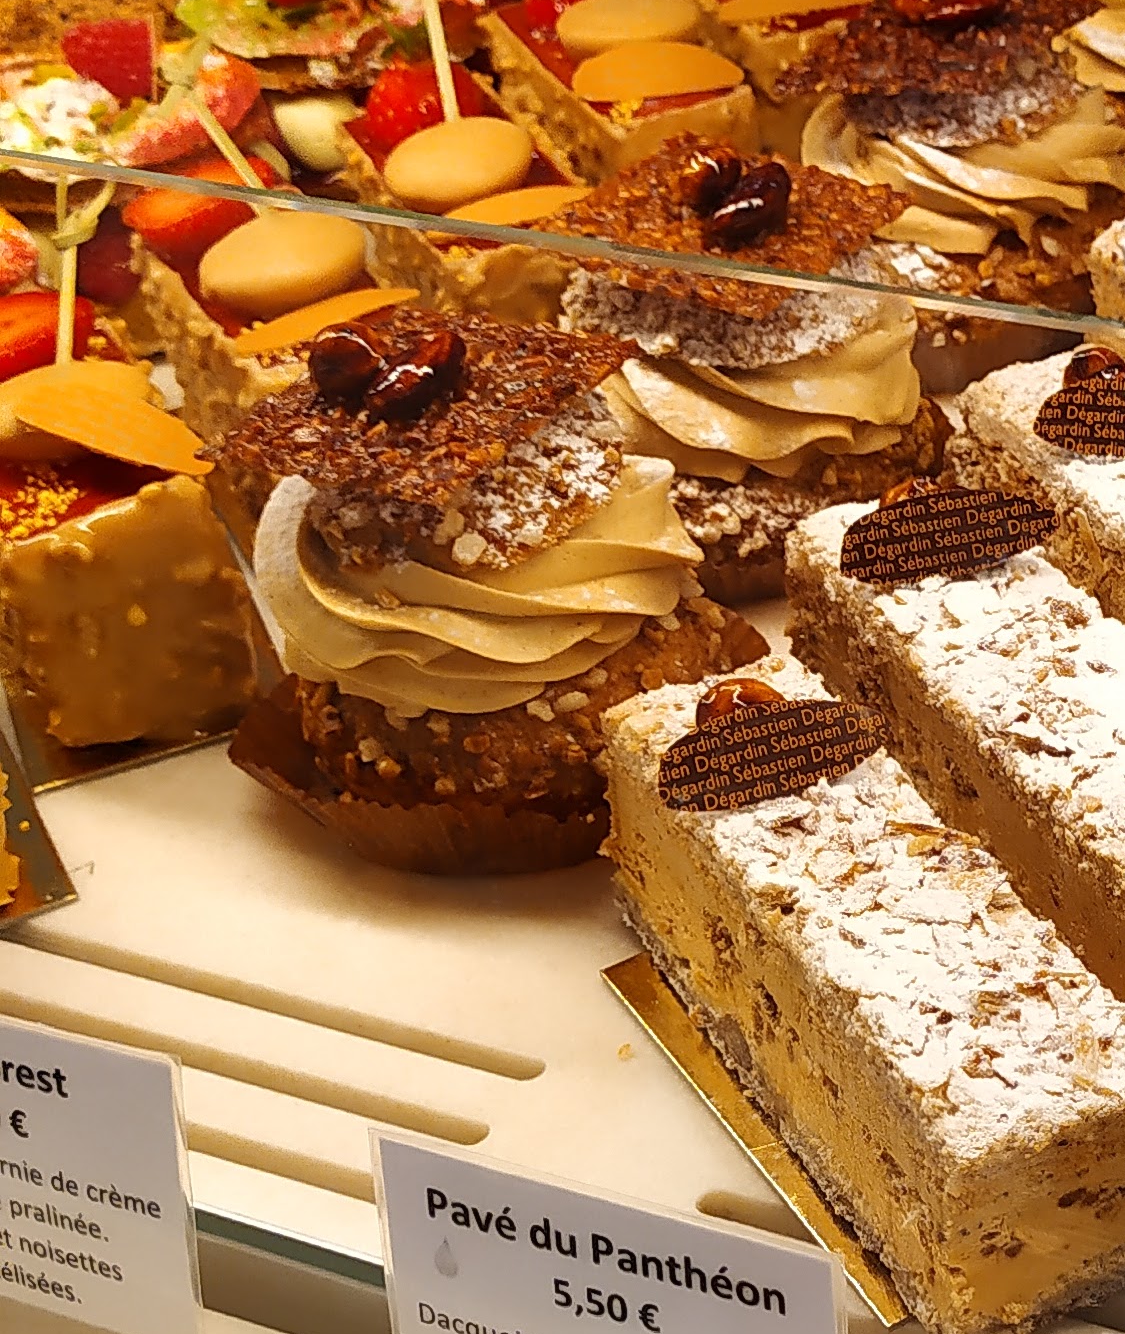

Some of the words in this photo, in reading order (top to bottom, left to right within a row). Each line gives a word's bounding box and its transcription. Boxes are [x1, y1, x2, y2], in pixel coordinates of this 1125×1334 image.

[892, 515, 962, 537] Sébastien
[966, 501, 1032, 525] Dégardin
[928, 491, 998, 514] Sébastien
[864, 535, 932, 561] Dégardin
[934, 526, 1003, 548] Sébastien
[898, 550, 967, 572] Sébastien
[971, 536, 1037, 559] Dégardin
[694, 742, 768, 773] Dégardin
[770, 726, 842, 753] Sébastien
[723, 715, 797, 746] Sébastien
[733, 753, 807, 783] Sébastien
[810, 734, 878, 763] Dégardin
[703, 779, 777, 811] Dégardin
[51, 1171, 79, 1197] de
[87, 1183, 162, 1219] crème
[10, 1198, 109, 1243] pralinée.
[19, 1233, 123, 1282] noisettes
[426, 1187, 517, 1241] Pavé
[530, 1217, 578, 1259] du
[591, 1233, 787, 1315] Panthéon
[553, 1277, 628, 1322] 5,50
[638, 1303, 661, 1333] €
